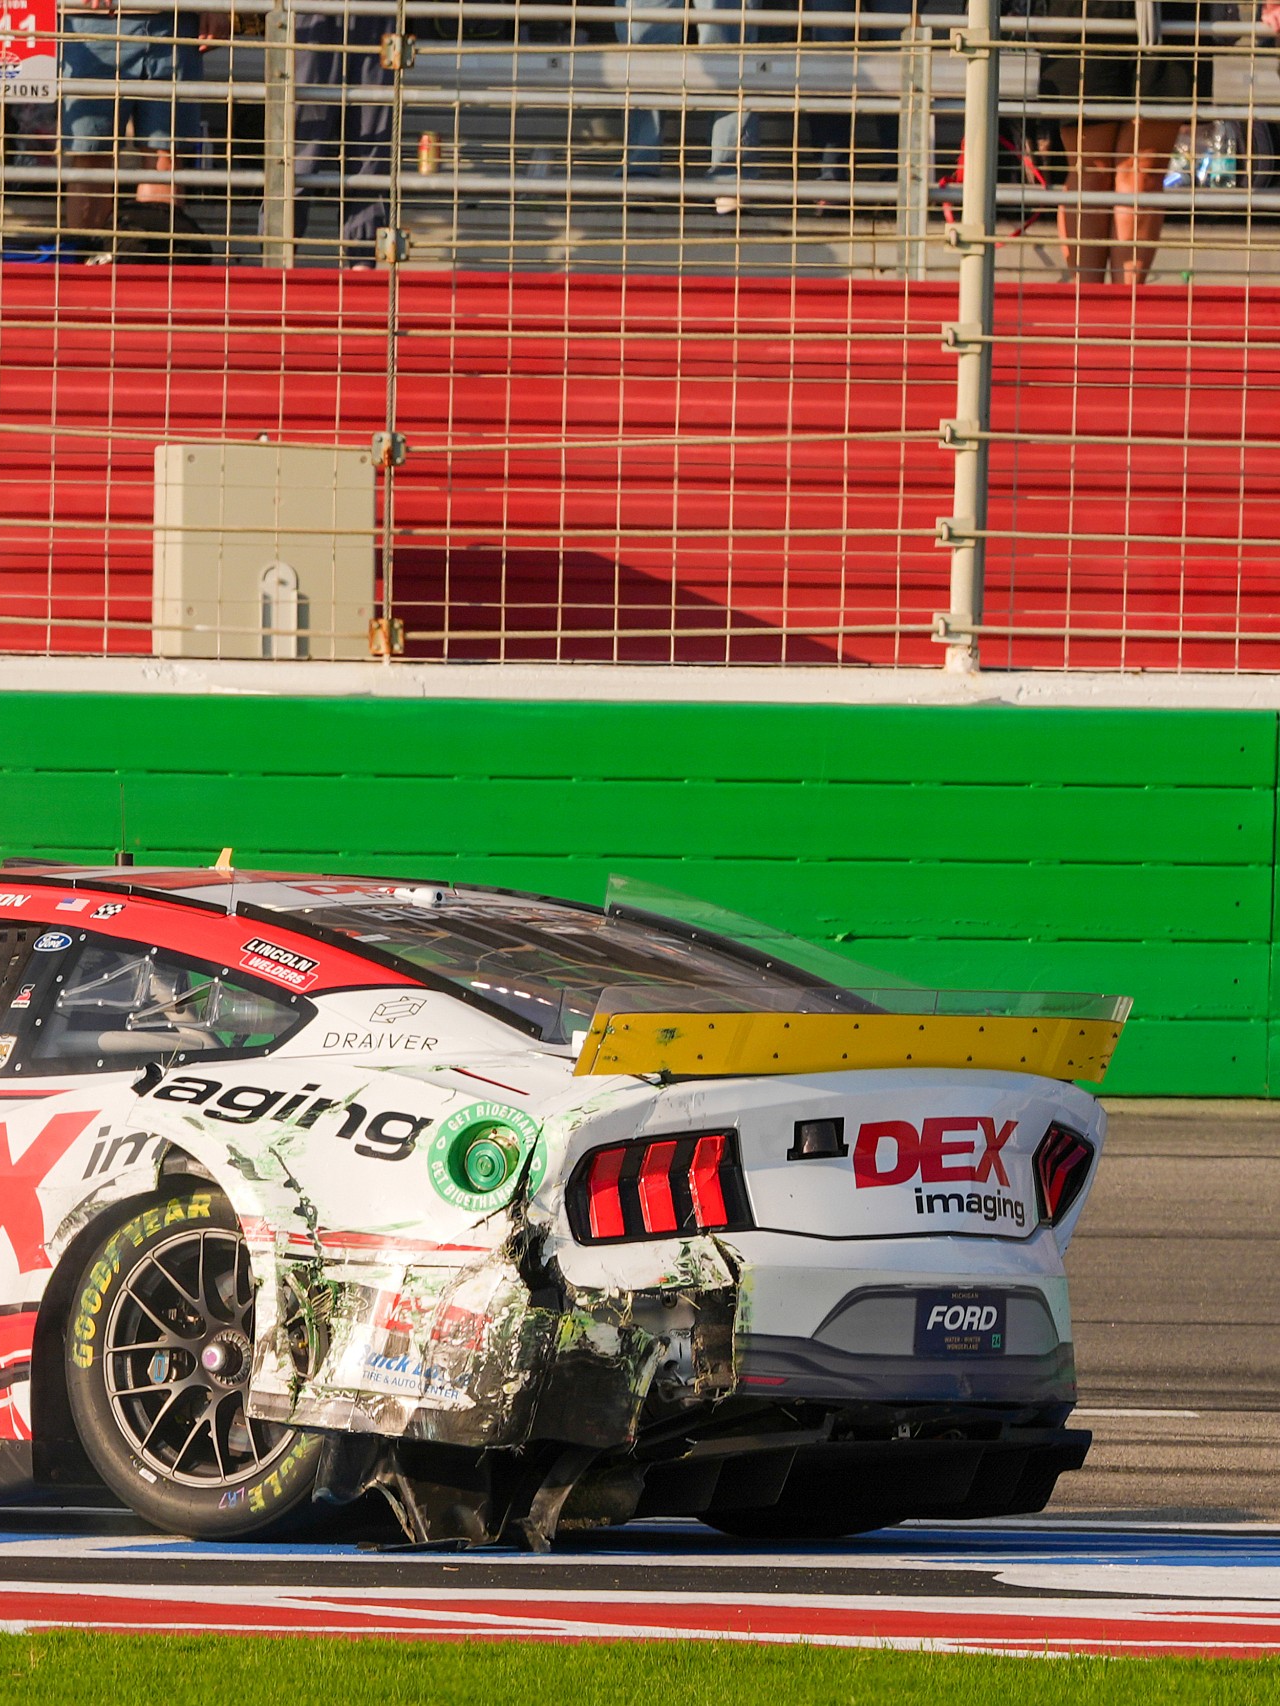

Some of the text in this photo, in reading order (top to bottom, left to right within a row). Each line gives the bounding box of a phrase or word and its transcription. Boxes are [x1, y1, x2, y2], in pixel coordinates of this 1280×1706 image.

[246, 940, 314, 972] LINCOLN
[248, 956, 306, 985] WELDERS
[323, 1032, 439, 1052] DRAIVER
[447, 1109, 471, 1132] GET
[853, 1116, 1019, 1189] DEX
[431, 1160, 449, 1185] GET
[914, 1187, 1025, 1227] imaging
[926, 1305, 998, 1331] FORD
[362, 1370, 382, 1382] TIRE
[384, 1375, 390, 1384] &
[391, 1376, 415, 1390] AUTO
